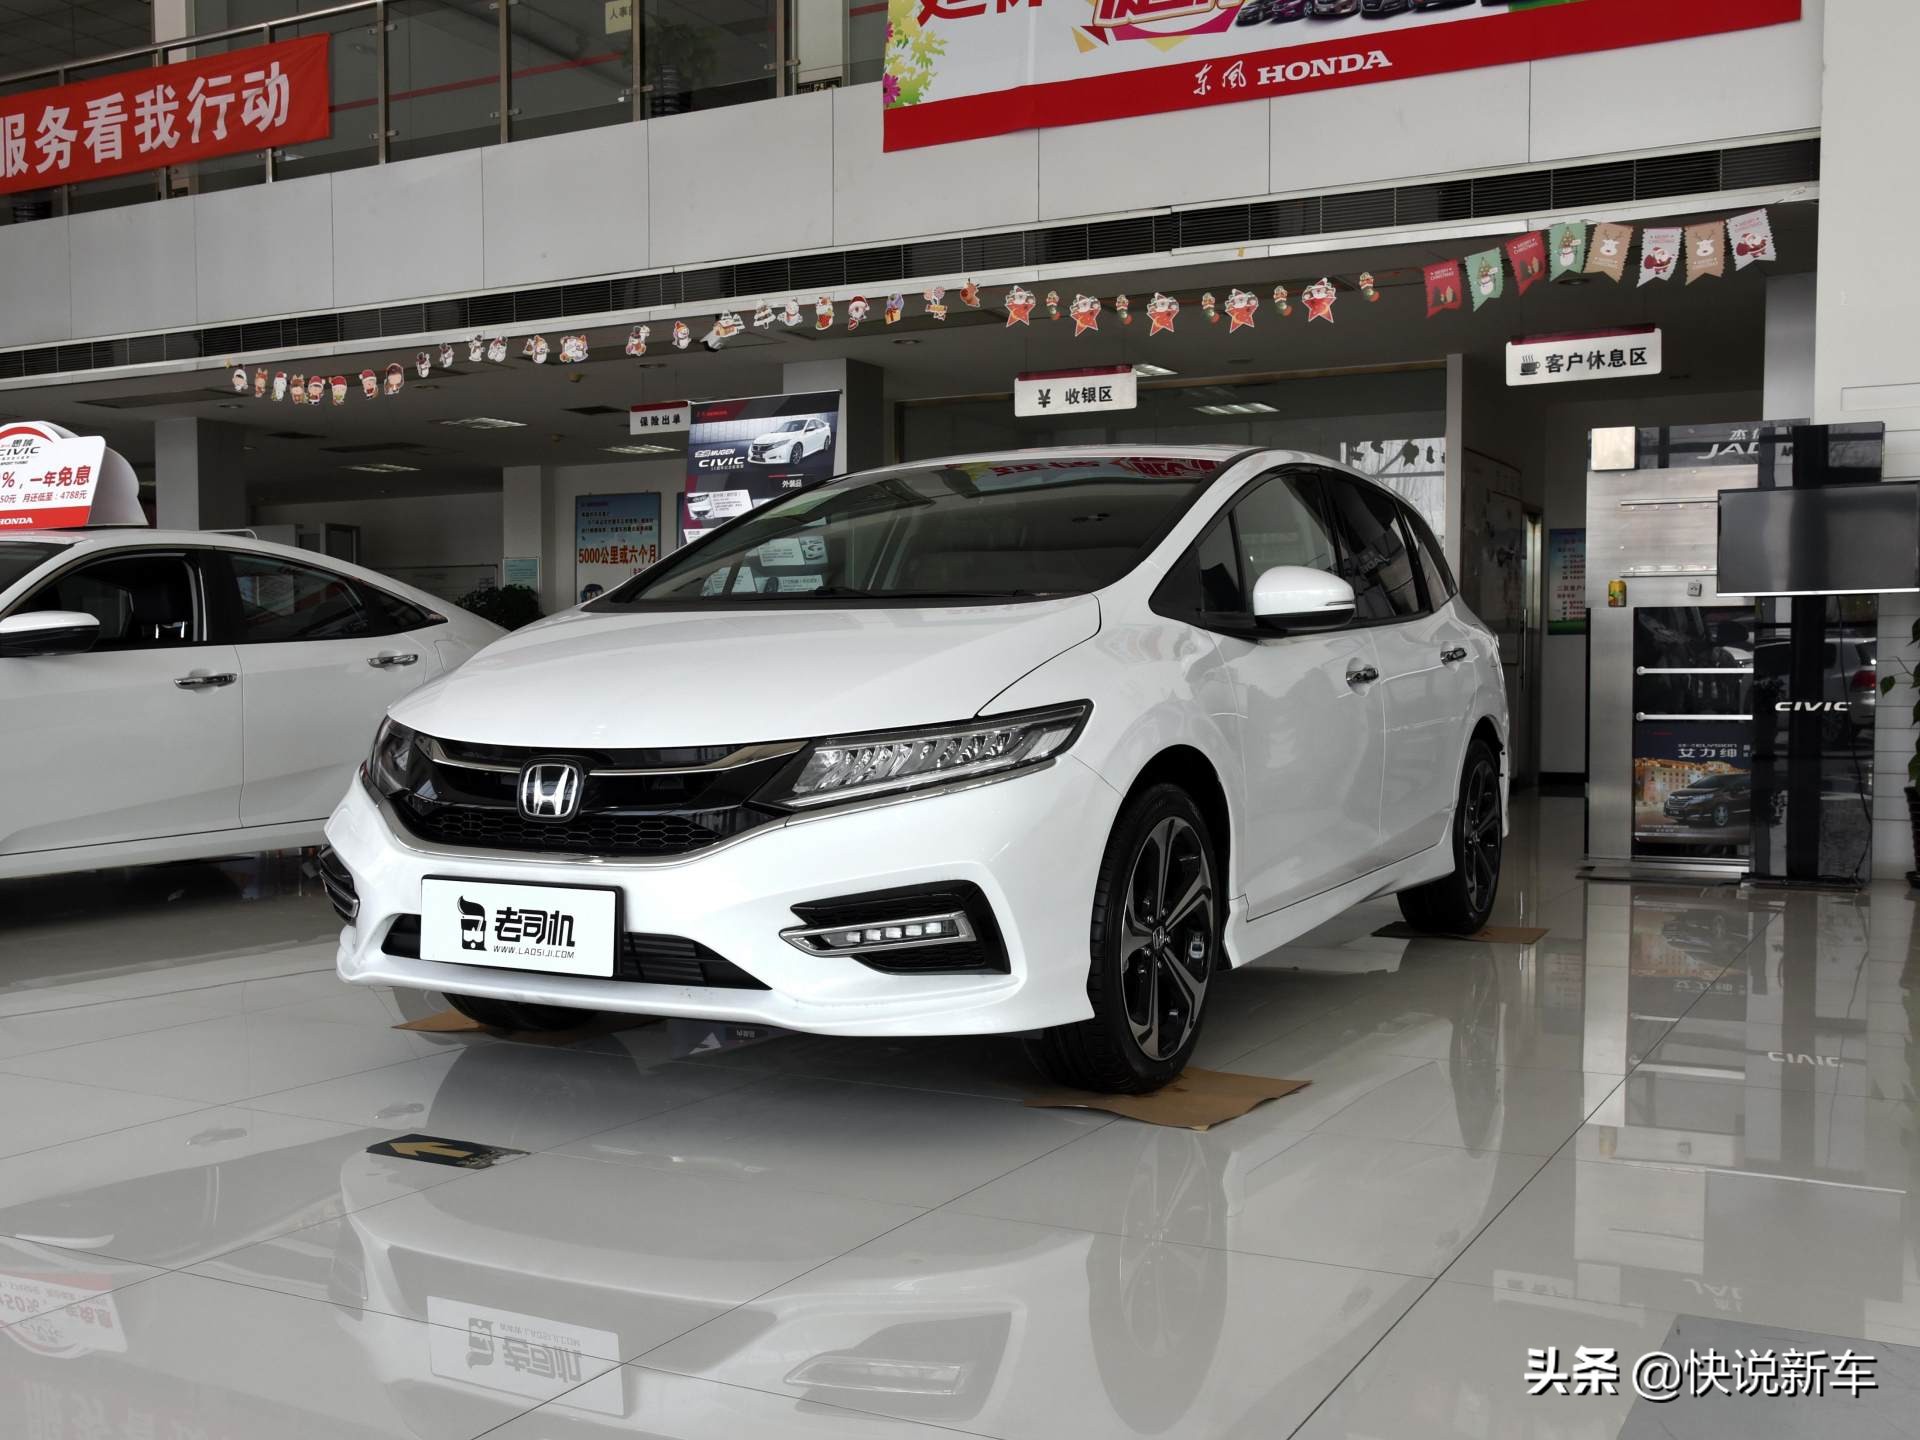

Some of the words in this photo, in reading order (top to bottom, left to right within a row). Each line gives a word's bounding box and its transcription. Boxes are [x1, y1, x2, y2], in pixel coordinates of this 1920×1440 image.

[1257, 50, 1392, 85] HONDA
[0, 61, 290, 178] 服务看我行动
[1545, 347, 1648, 373] 客户休息区
[1065, 386, 1113, 405] 收银区
[640, 413, 681, 427] 保险出单
[698, 456, 745, 468] CIVIC
[578, 544, 657, 565] 5000公里或六个月
[1775, 701, 1852, 712] CIVIC
[1678, 748, 1737, 758] 艾力绅
[494, 906, 576, 947] 老司机
[493, 945, 575, 959] WWW.LAOSIJI.COM
